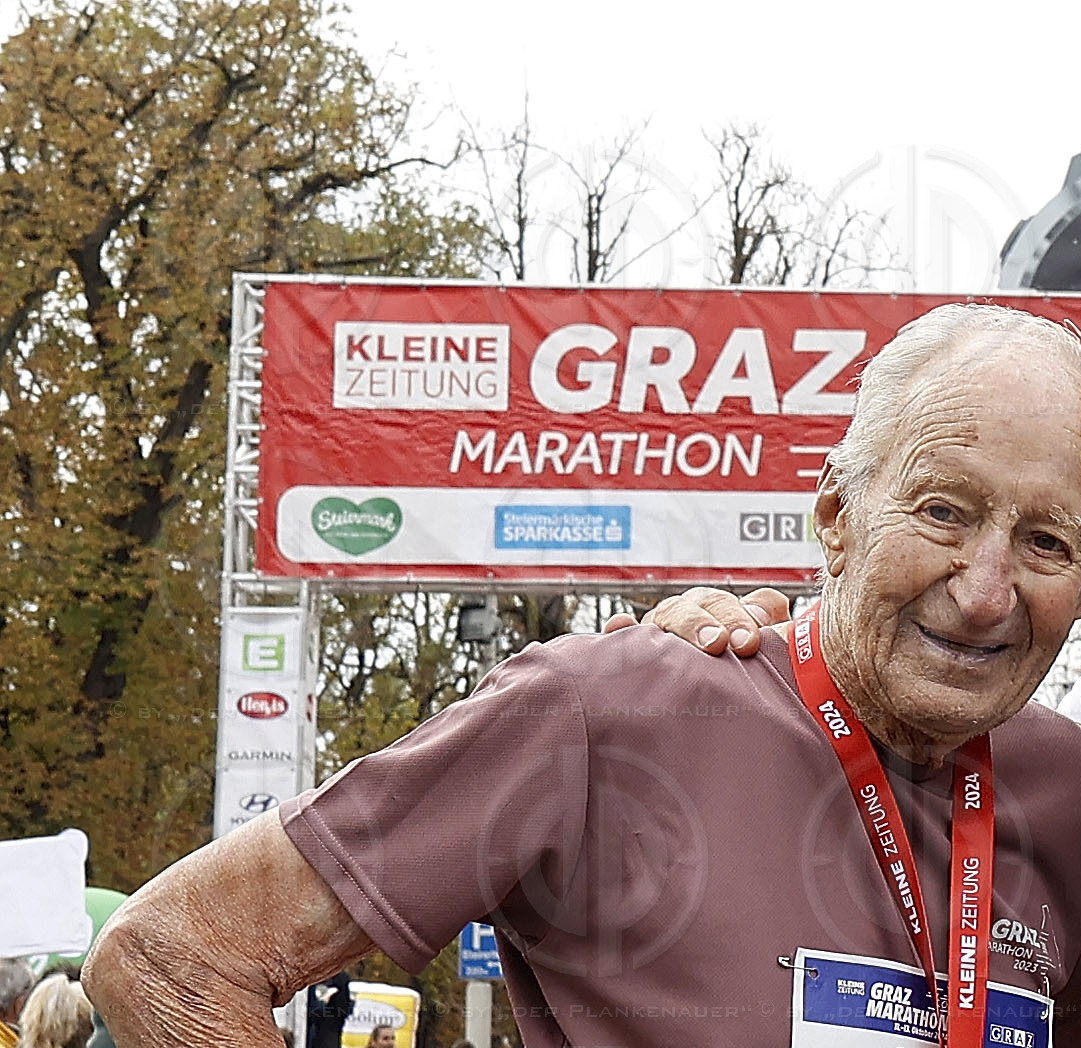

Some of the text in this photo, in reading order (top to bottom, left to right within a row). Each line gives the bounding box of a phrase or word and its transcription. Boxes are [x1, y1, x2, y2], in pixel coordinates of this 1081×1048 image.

[346, 334, 499, 365] KLEINE
[344, 367, 498, 400] ZEITUNG
[530, 324, 868, 416] GRAZ
[449, 430, 764, 479] MARATHON
[503, 526, 603, 542] SPARKASSE
[504, 512, 604, 526] Steiermärkische
[241, 697, 285, 716] Hervis
[819, 700, 851, 739] 2024
[228, 751, 292, 762] GARMIN
[964, 773, 980, 810] 2024
[859, 784, 922, 935] KLEINE ZEITUNG
[959, 857, 980, 1010] KLEINE ZEITUNG
[991, 919, 1041, 949] GRAZ
[988, 941, 1033, 960] ARATHON
[1013, 959, 1039, 973] 2023
[870, 982, 913, 1006] GRAZ
[865, 999, 949, 1032] MARATHON
